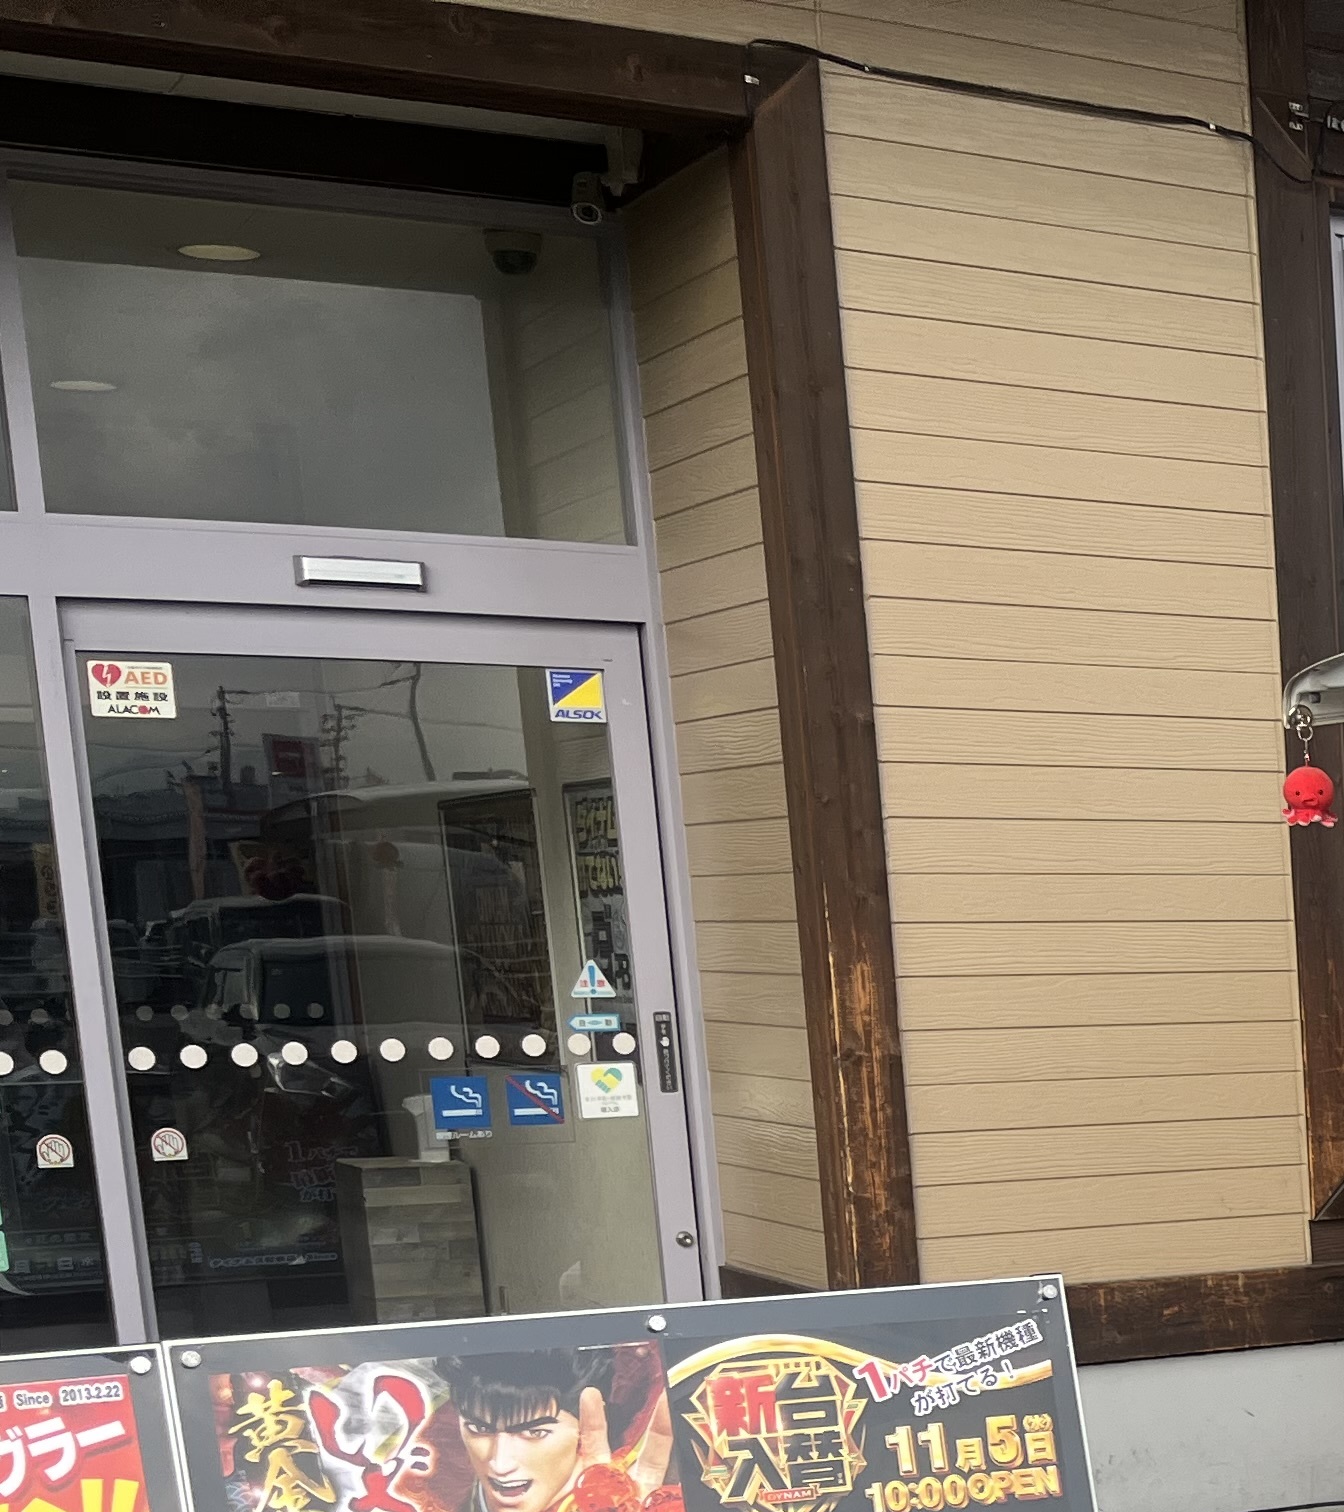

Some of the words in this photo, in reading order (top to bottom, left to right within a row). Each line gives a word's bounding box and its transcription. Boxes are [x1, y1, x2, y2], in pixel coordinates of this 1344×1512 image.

[124, 671, 168, 685] AED
[107, 704, 161, 715] ALACOM
[555, 709, 603, 720] ALSOK
[16, 1393, 50, 1407] Since
[61, 1385, 121, 1403] 2013.2.22
[767, 1488, 814, 1502] DYNAM
